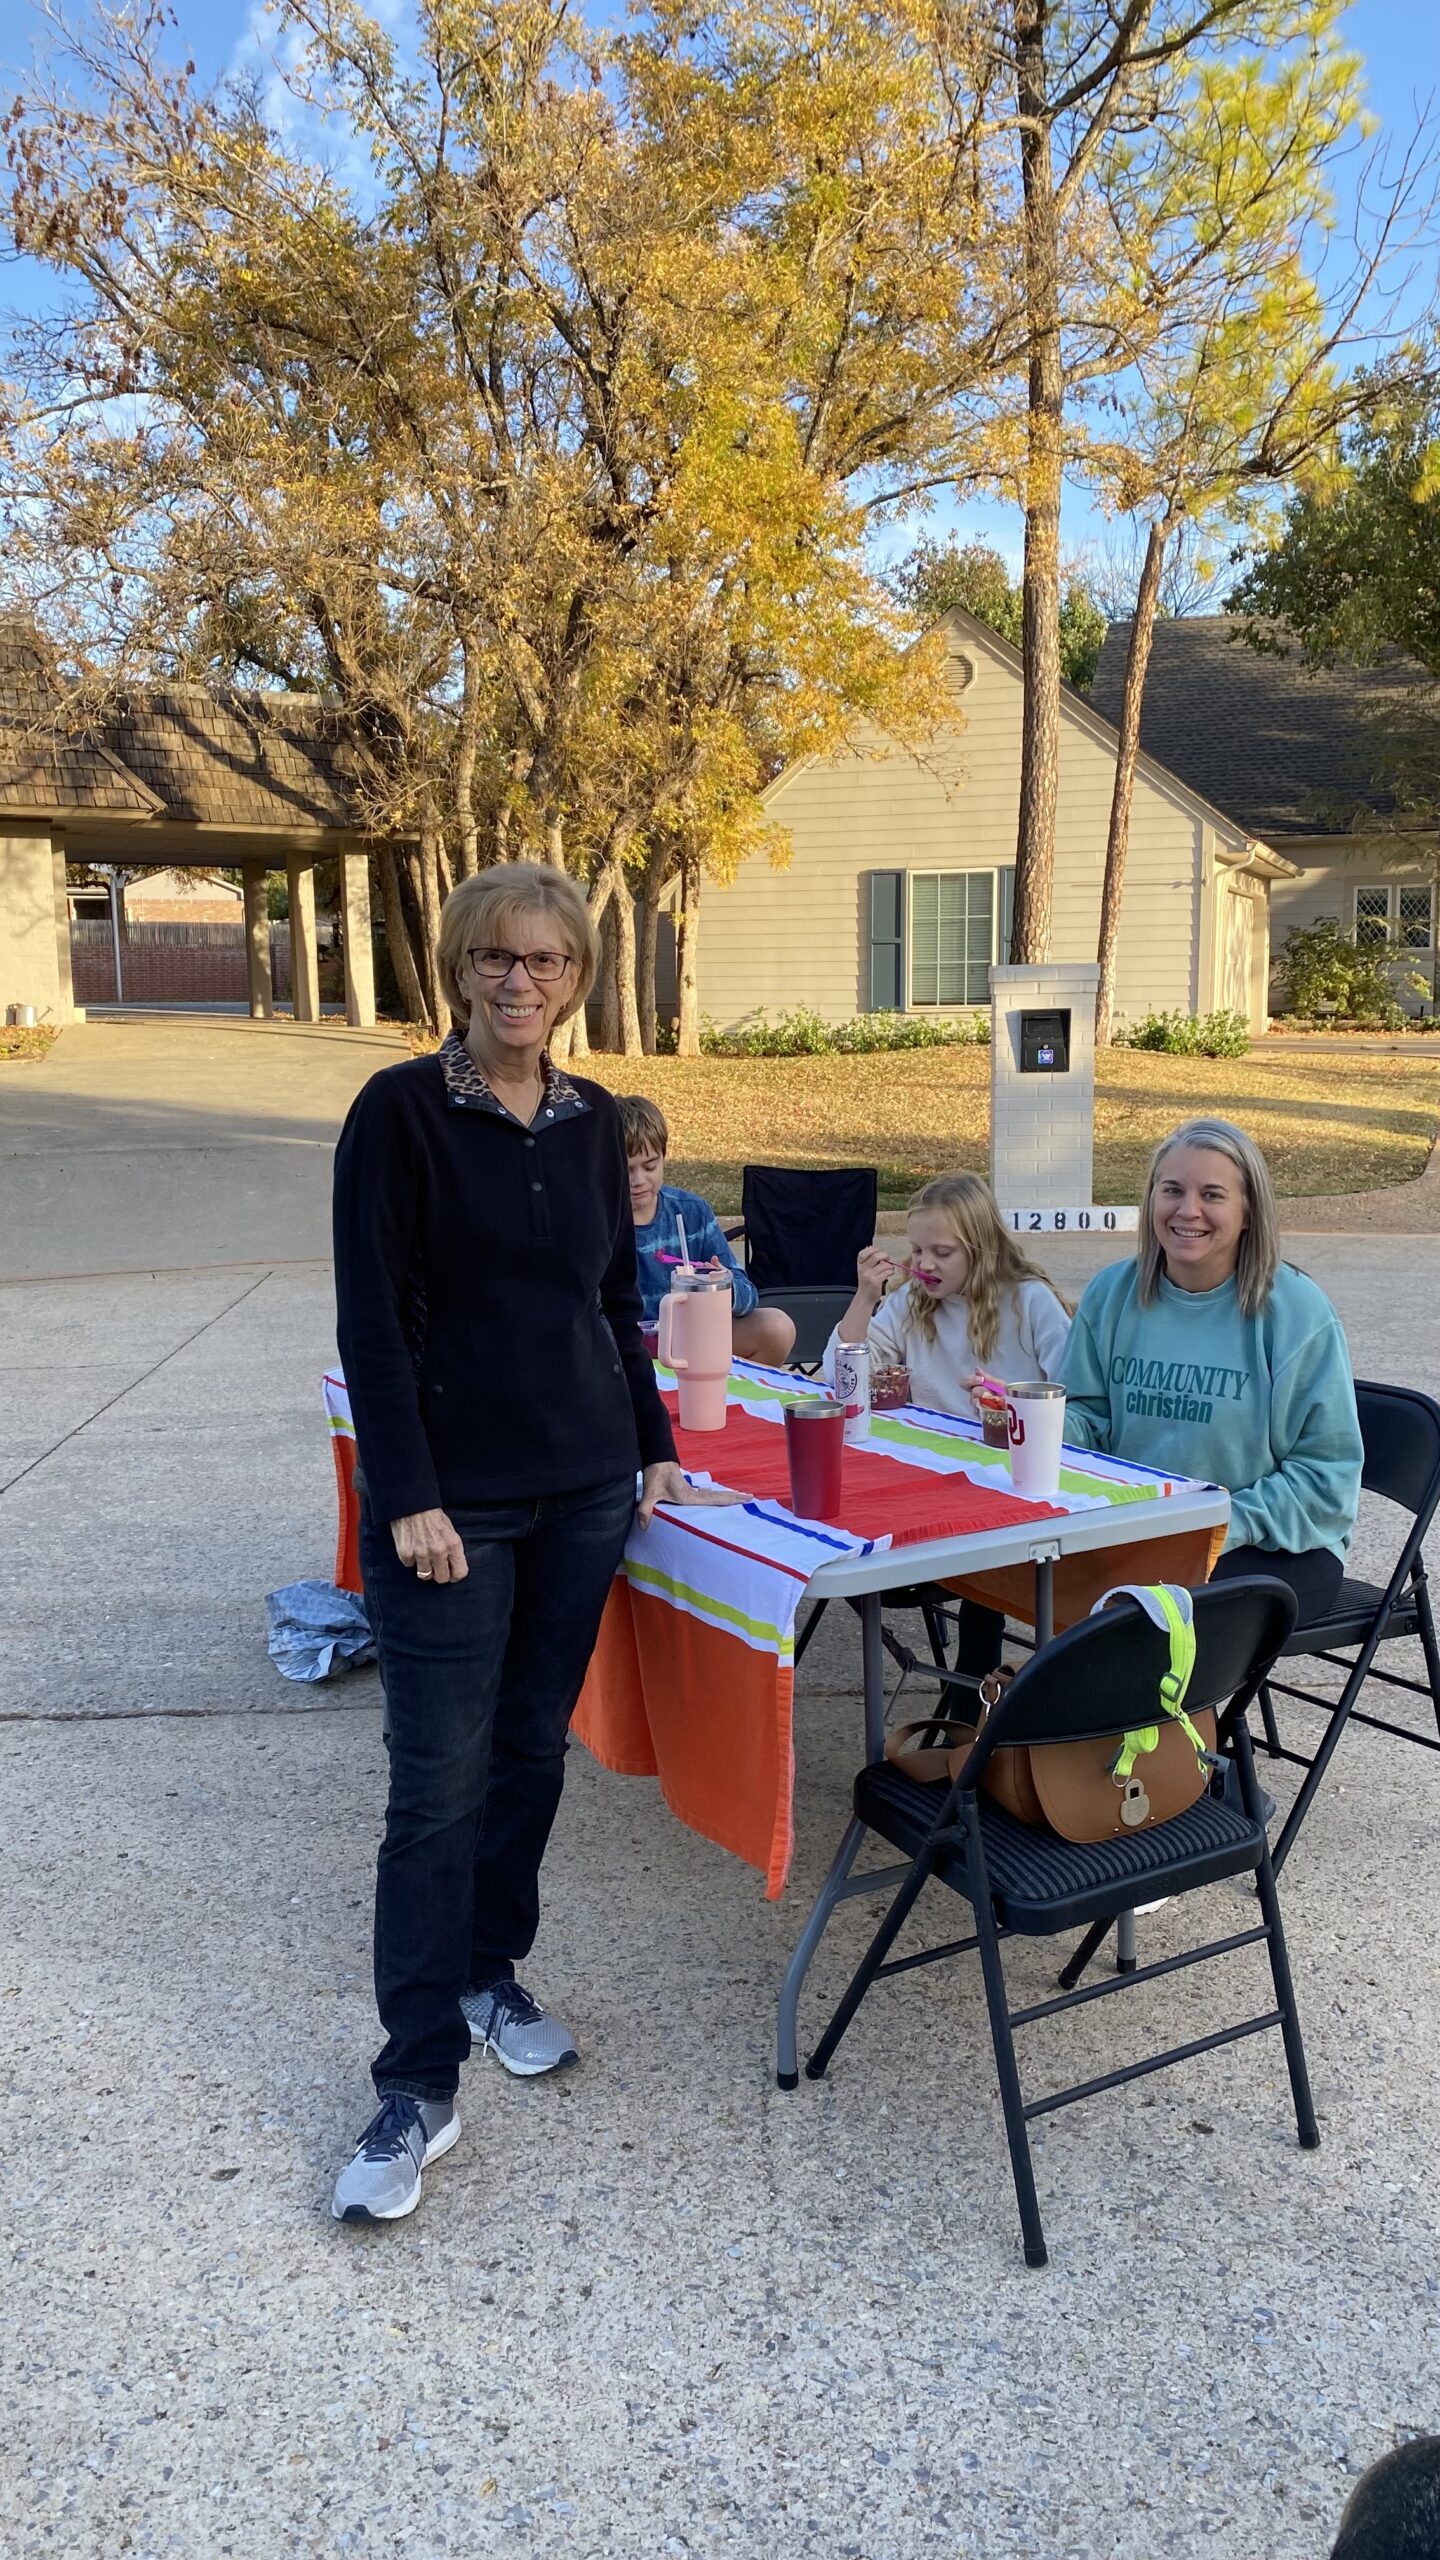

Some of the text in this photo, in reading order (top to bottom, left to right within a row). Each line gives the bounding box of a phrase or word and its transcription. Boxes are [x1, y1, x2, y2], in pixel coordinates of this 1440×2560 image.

[1013, 1212, 1116, 1231] 12800
[1111, 1356, 1250, 1401] COMMUNITY
[1126, 1389, 1213, 1424] christian
